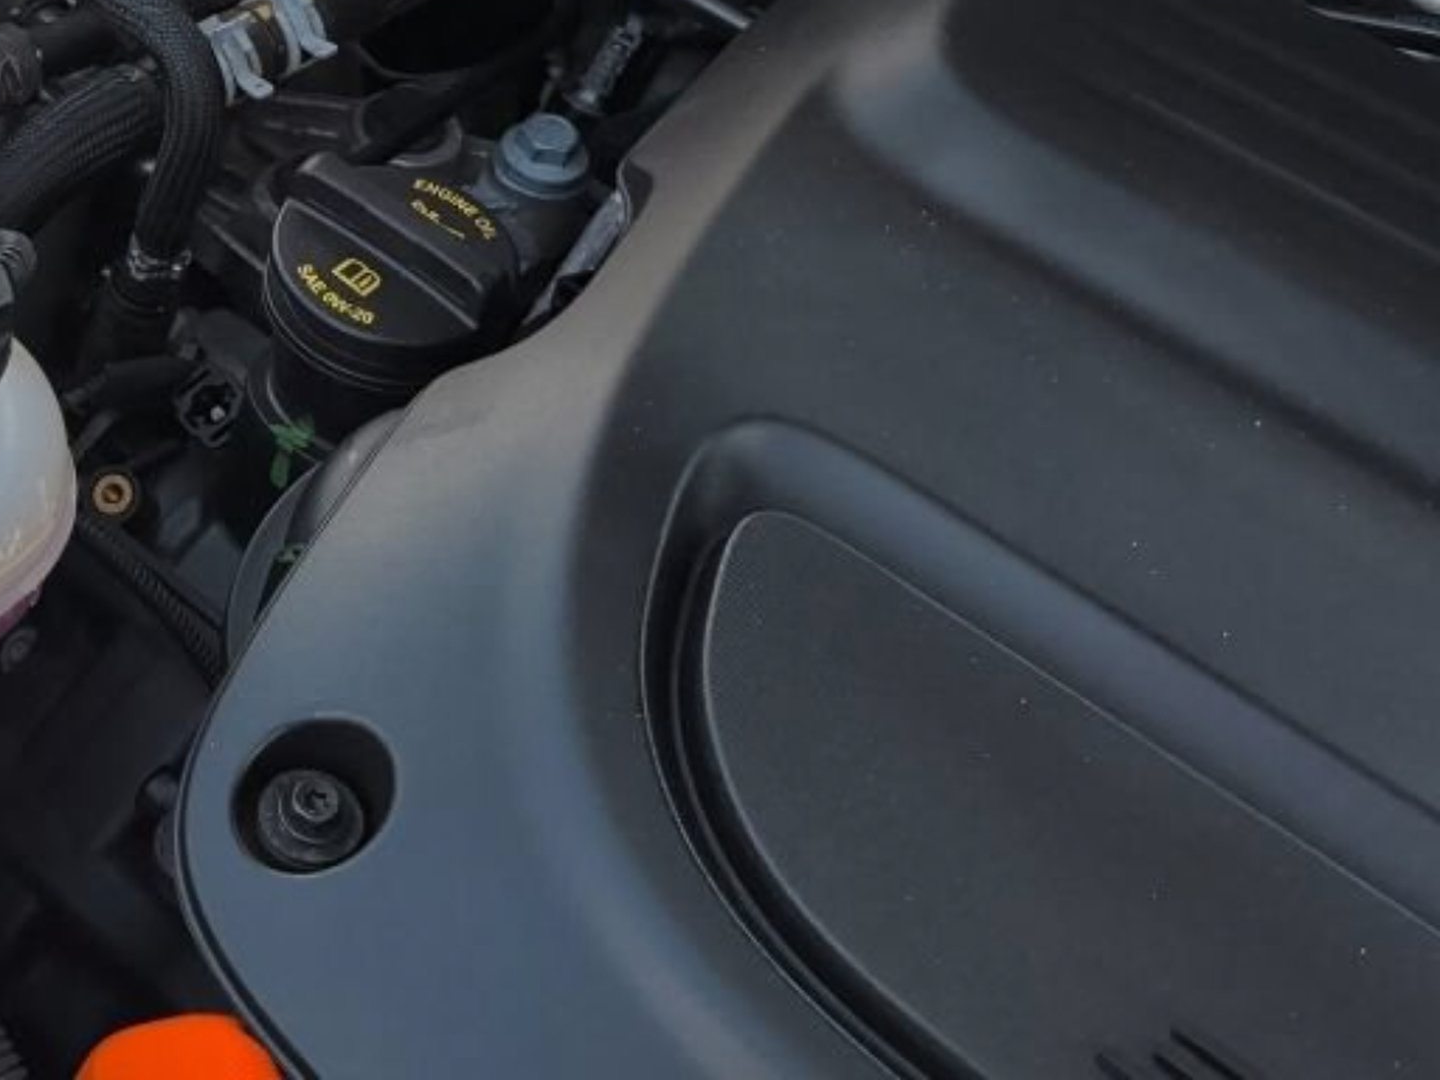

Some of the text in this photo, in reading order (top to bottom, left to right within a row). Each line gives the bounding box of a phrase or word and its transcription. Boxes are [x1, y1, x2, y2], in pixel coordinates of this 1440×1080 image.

[413, 178, 497, 240] ENGINE OIL
[297, 263, 328, 294] SAE
